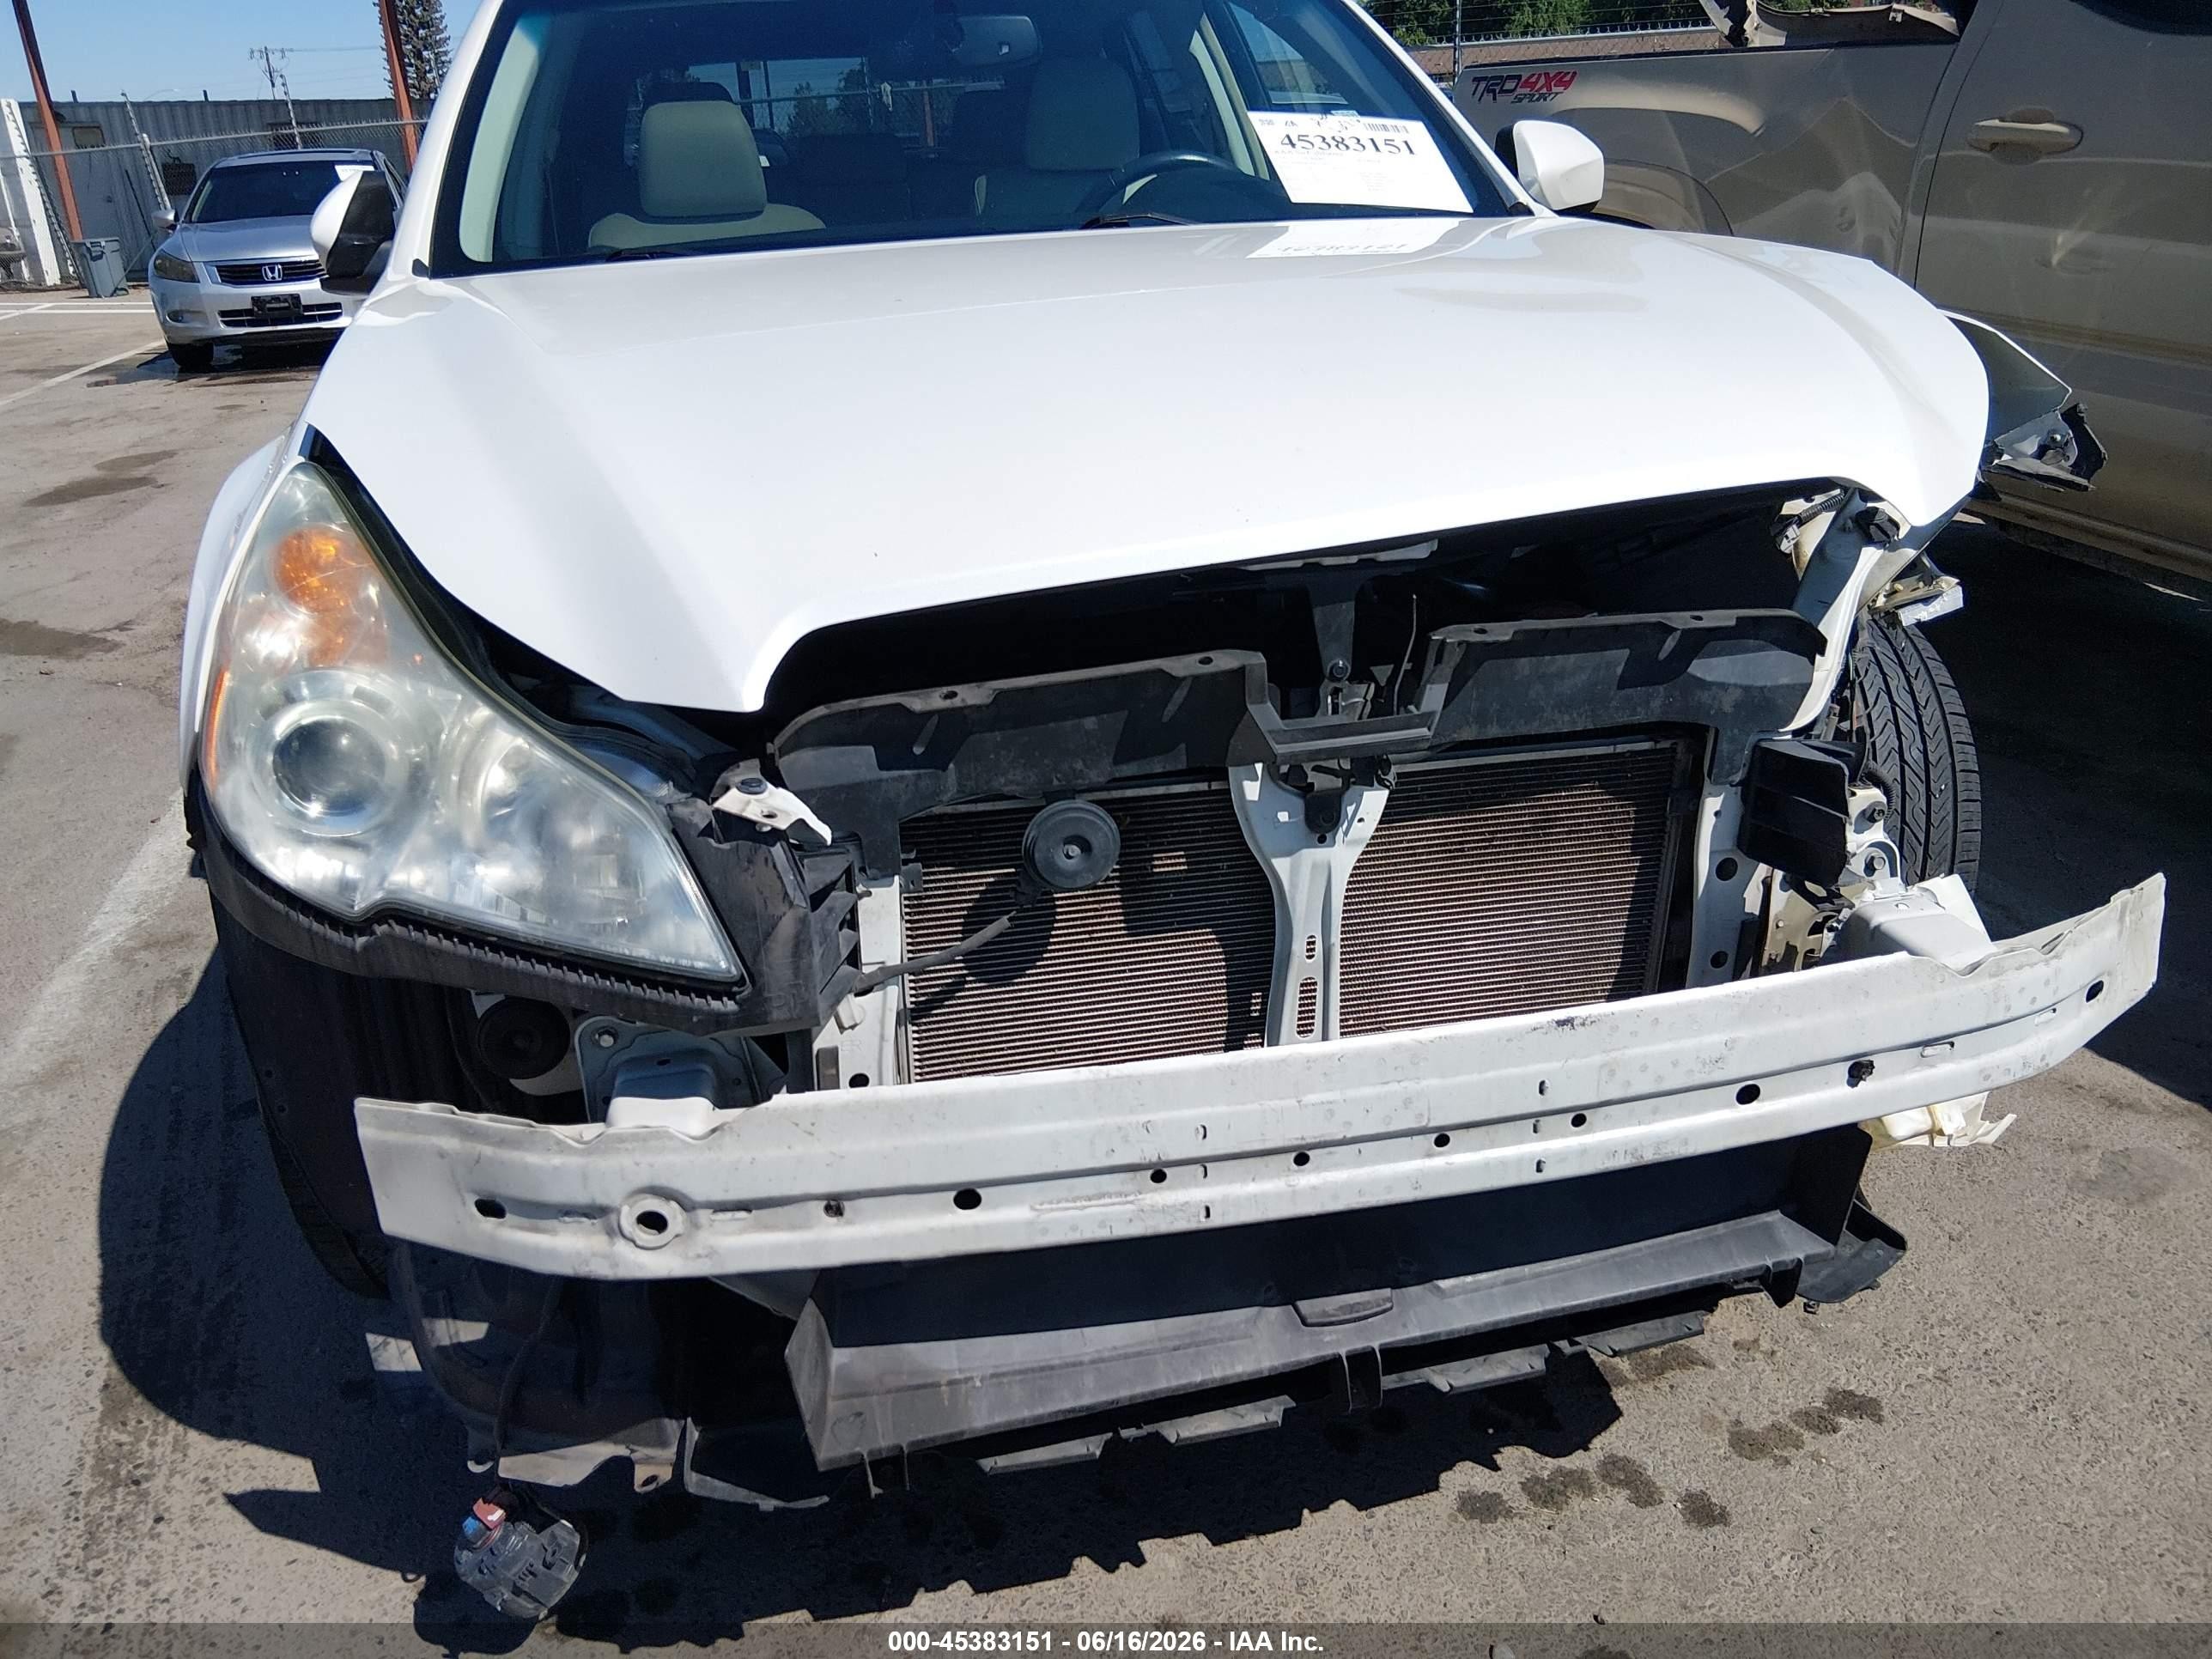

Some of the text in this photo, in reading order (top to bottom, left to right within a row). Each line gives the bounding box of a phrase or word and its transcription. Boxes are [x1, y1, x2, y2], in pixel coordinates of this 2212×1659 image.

[1472, 74, 1522, 103] TRD
[1510, 92, 1565, 103] SPORT
[1280, 133, 1415, 155] 45383151
